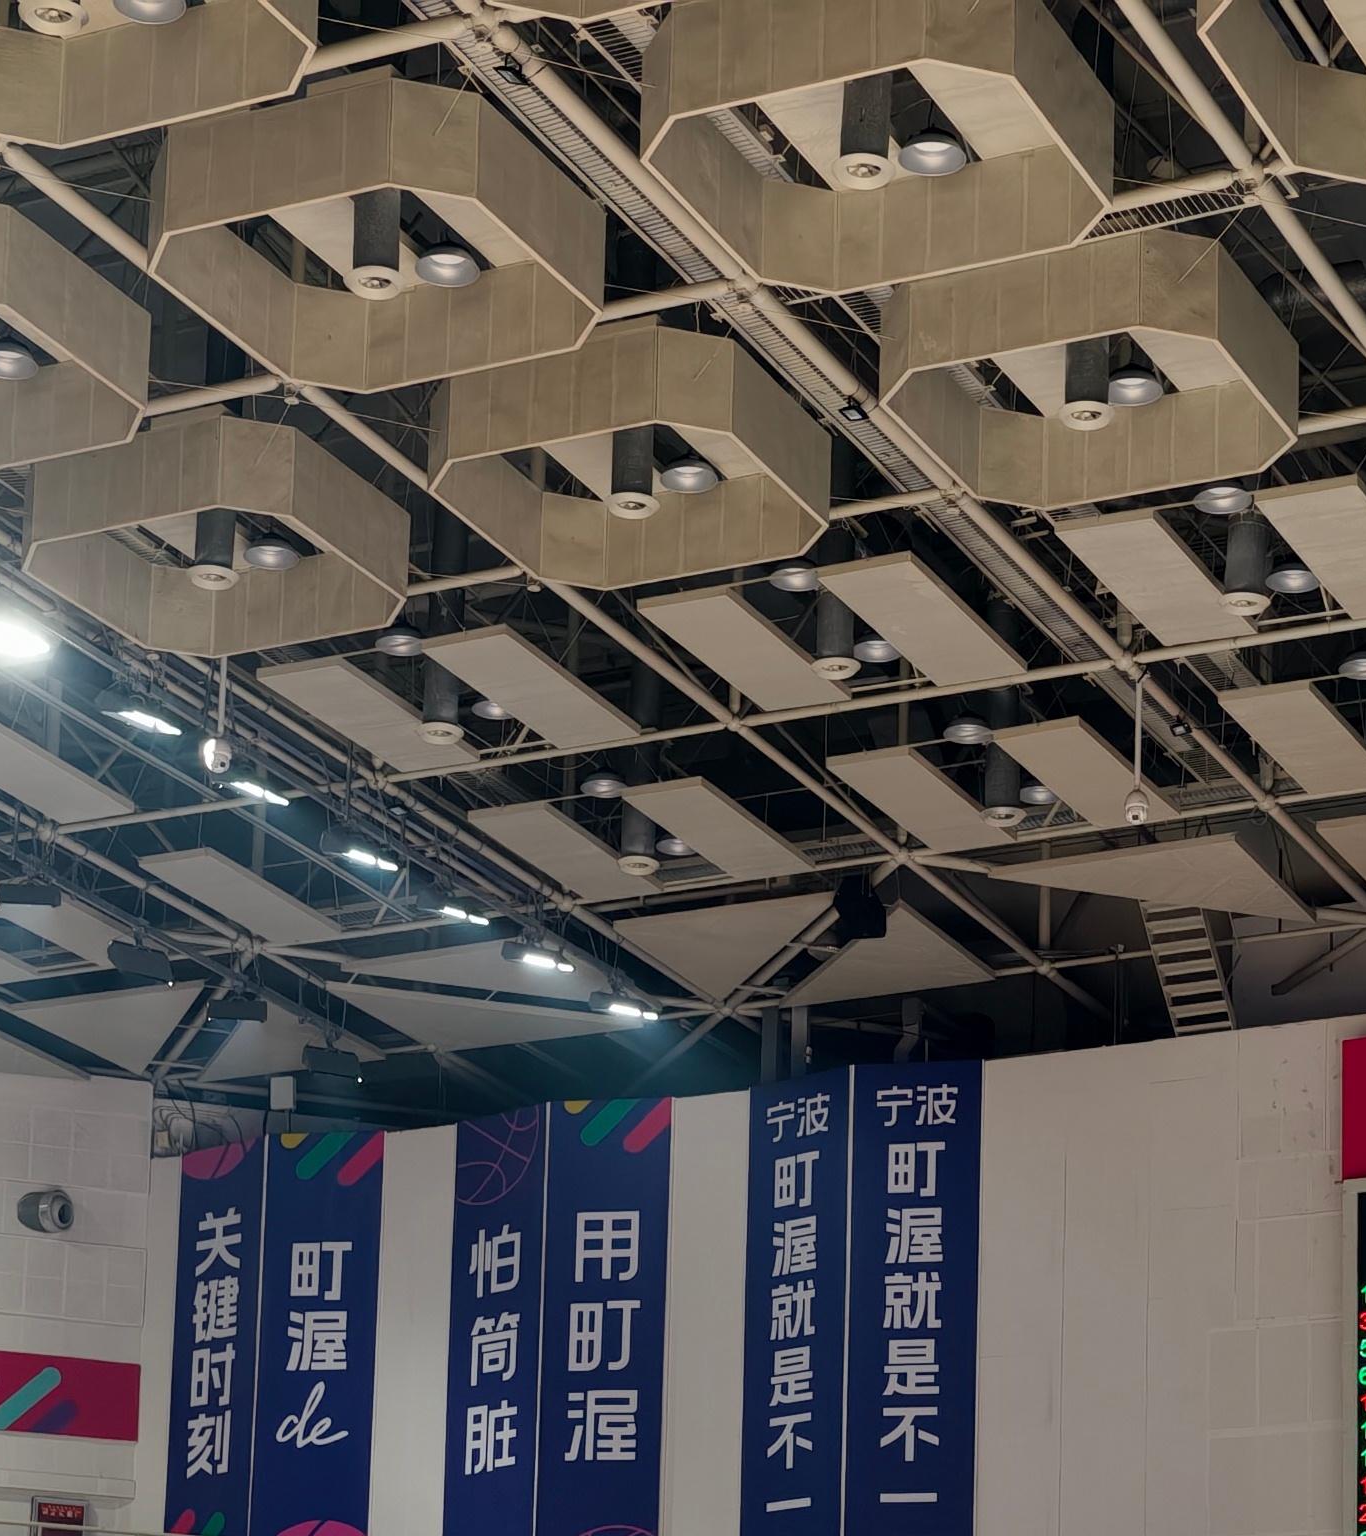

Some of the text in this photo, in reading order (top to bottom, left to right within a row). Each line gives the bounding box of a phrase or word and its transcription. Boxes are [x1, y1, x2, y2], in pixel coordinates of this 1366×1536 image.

[765, 1092, 832, 1143] 宁波
[875, 1082, 960, 1130] 宁波
[186, 1206, 243, 1480] 关键时刻
[286, 1240, 354, 1374] 町渥
[463, 1223, 524, 1478] 怕筒脏
[564, 1209, 642, 1464] 用町渥
[275, 1381, 349, 1450] de
